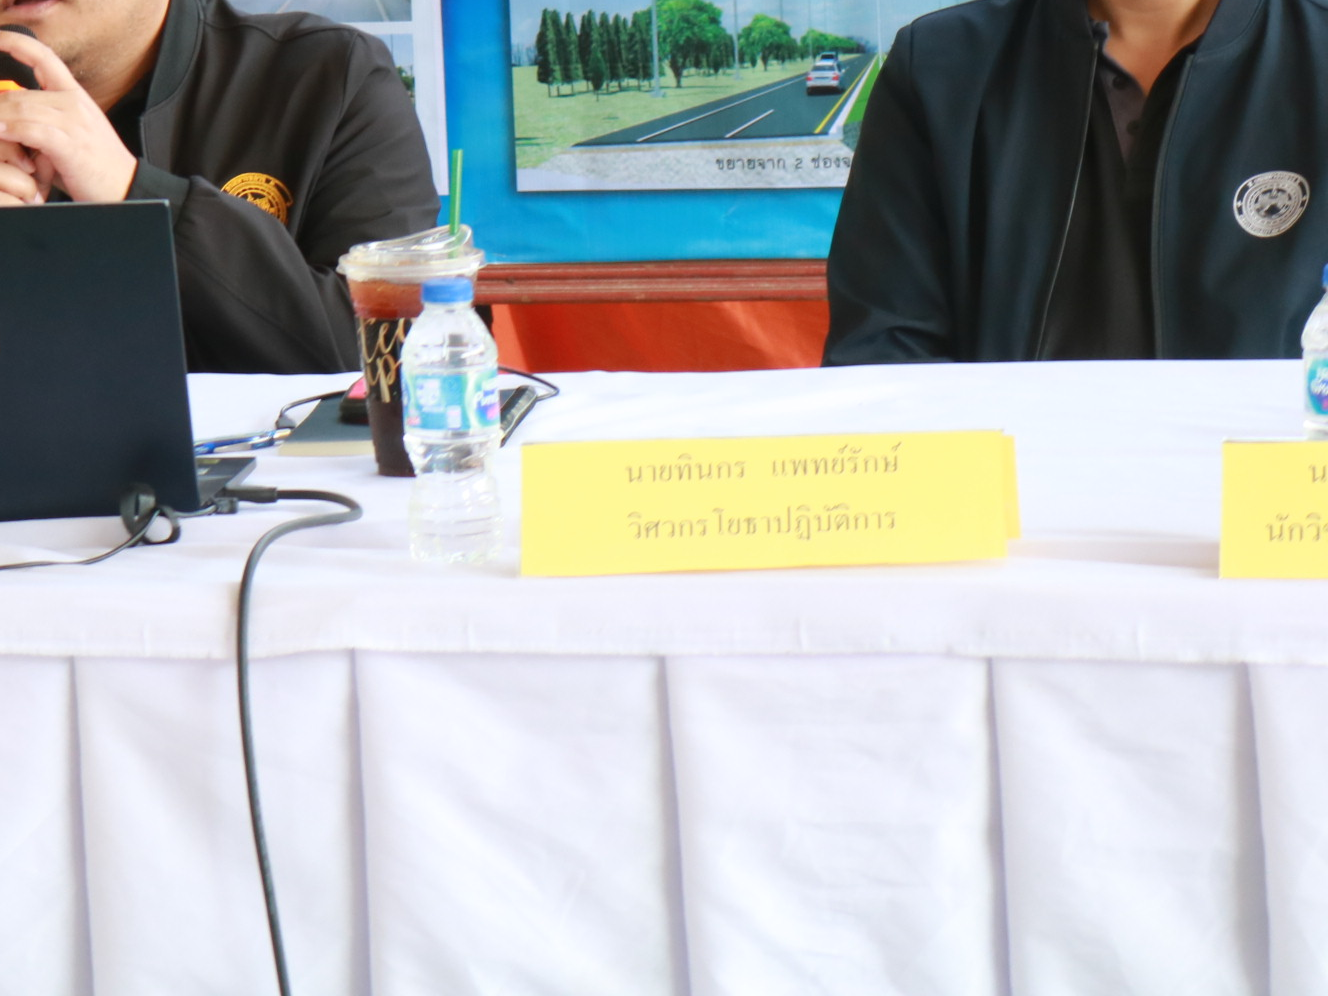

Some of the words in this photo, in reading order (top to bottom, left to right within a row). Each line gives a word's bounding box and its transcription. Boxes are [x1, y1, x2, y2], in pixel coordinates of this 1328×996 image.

[715, 157, 786, 171] ขยายจาก
[794, 157, 804, 170] 2
[810, 153, 852, 170] ช่องจ
[625, 453, 746, 484] นายทินกร
[771, 441, 902, 477] แพทย์รักษ์
